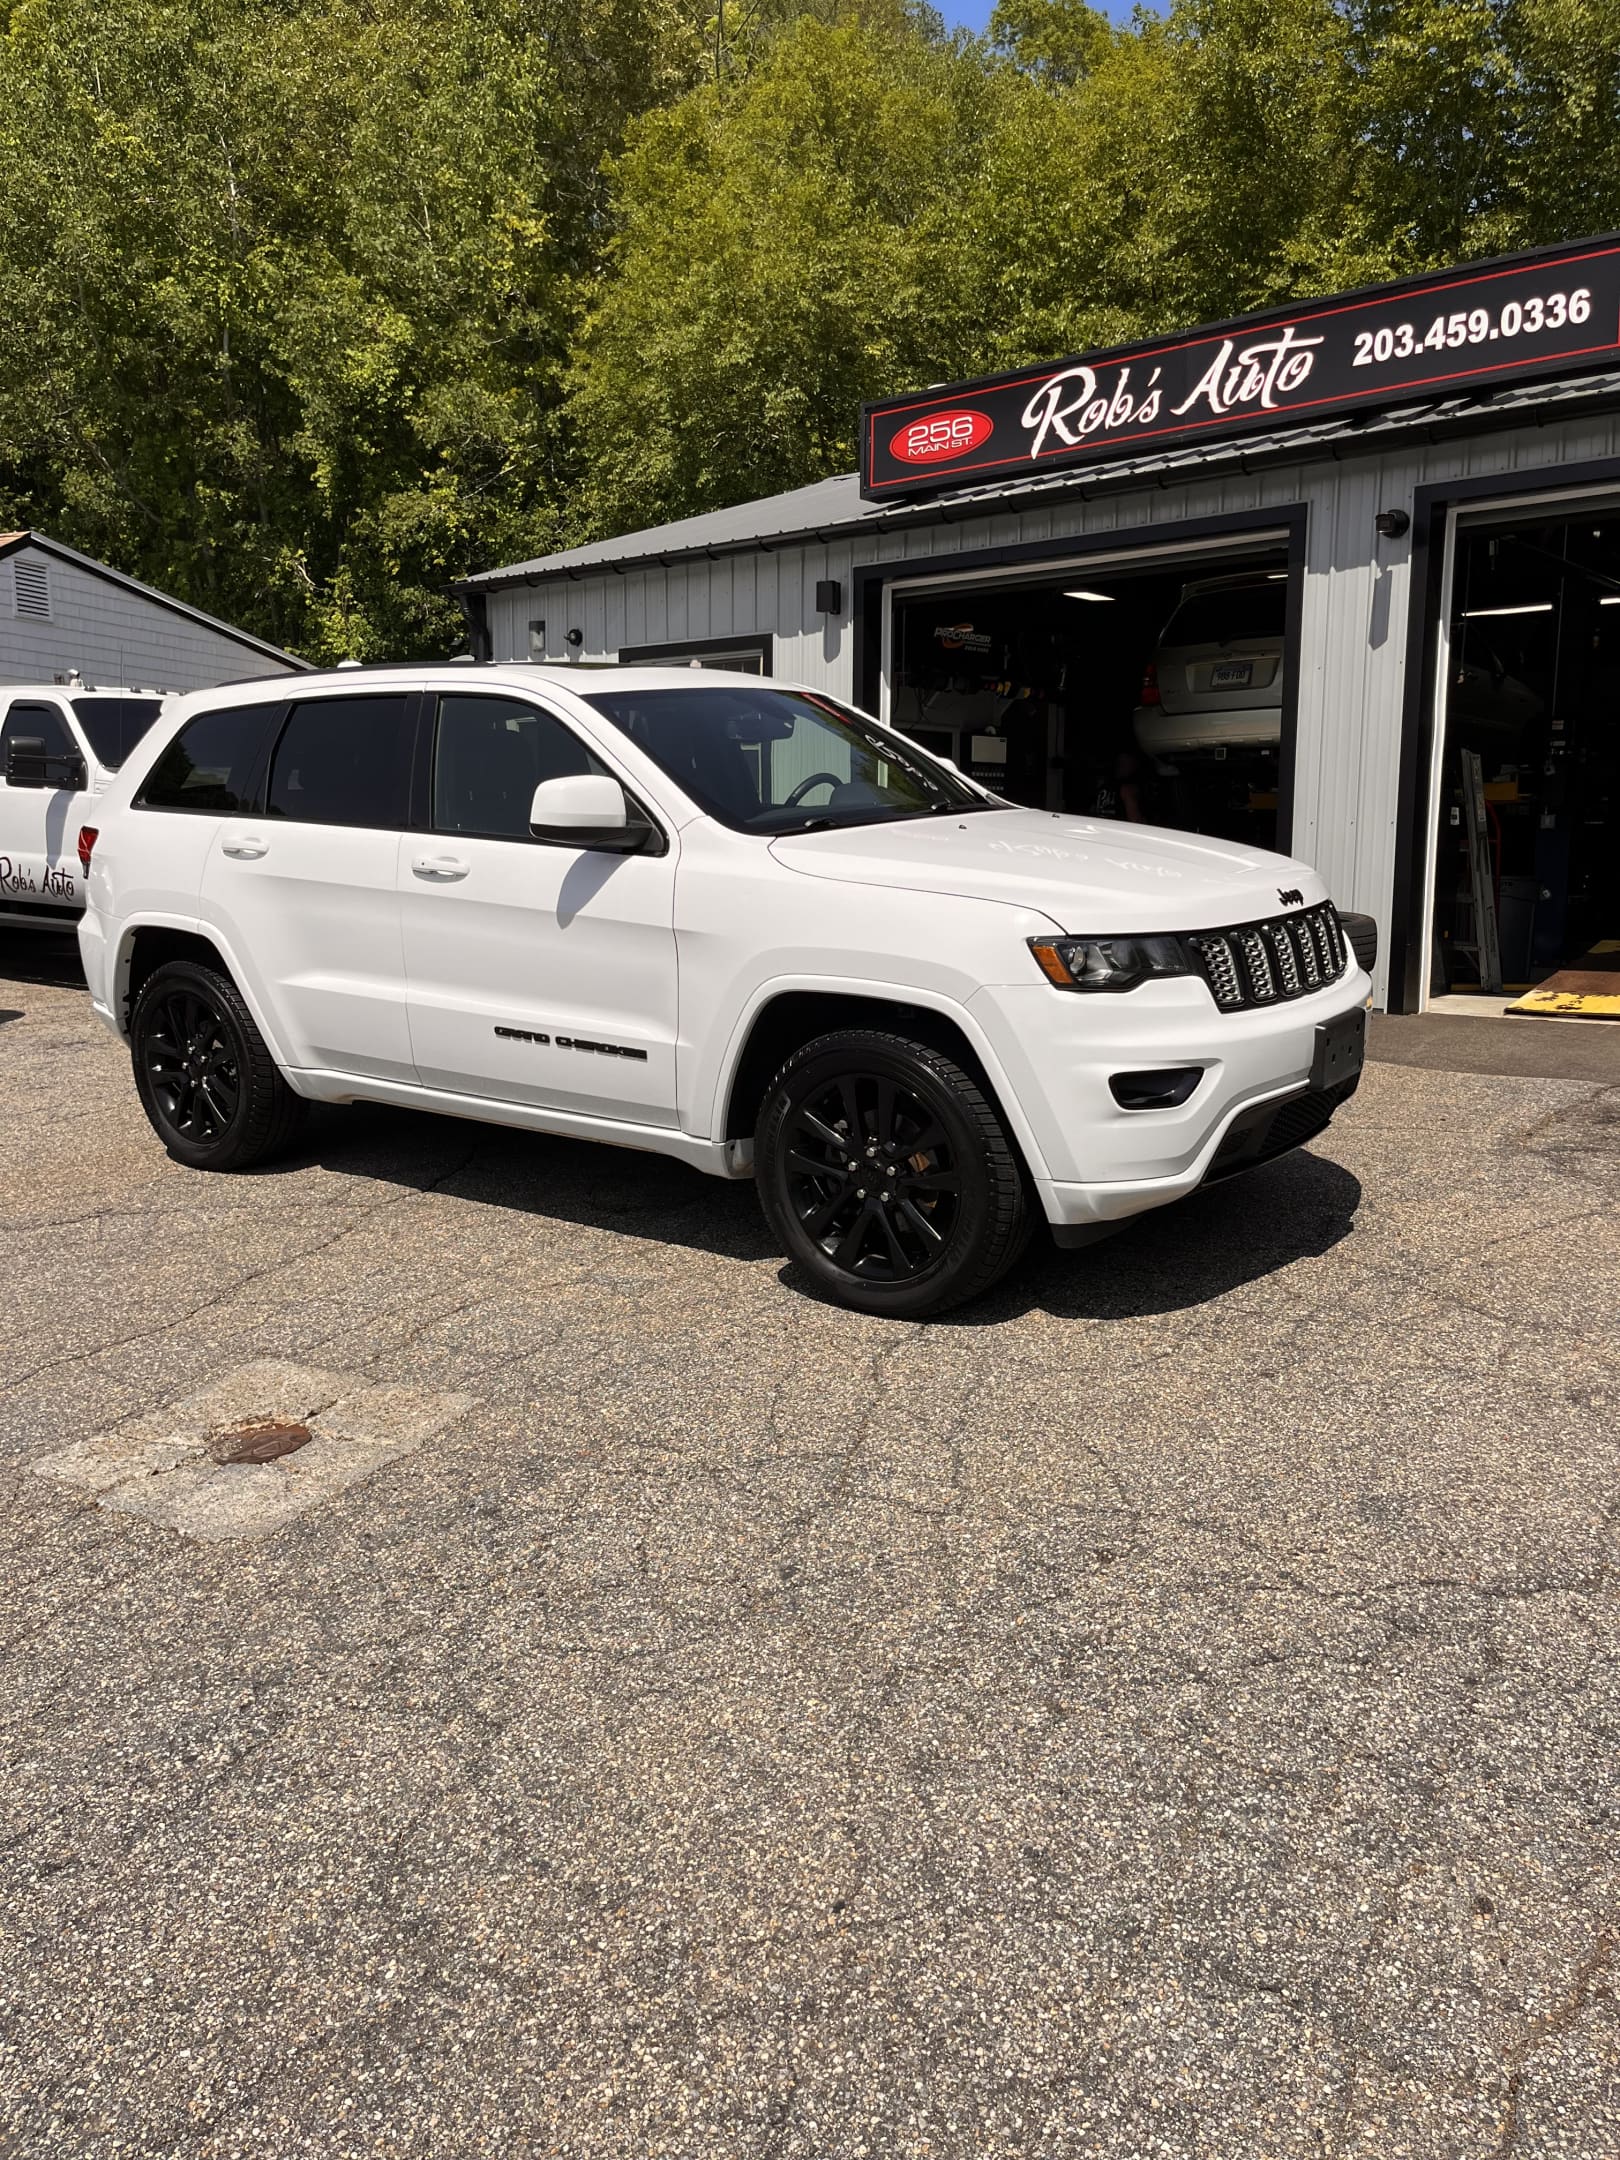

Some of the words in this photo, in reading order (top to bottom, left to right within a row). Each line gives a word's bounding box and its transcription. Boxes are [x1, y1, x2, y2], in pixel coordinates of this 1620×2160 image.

[1351, 288, 1592, 367] 203.459.0336
[1021, 366, 1163, 460] Rob's
[1169, 327, 1325, 415] Auto
[908, 416, 973, 447] 256
[908, 441, 949, 457] MAIN
[951, 436, 973, 448] ST.
[0, 856, 36, 896] Rob's
[41, 864, 74, 902] Auto
